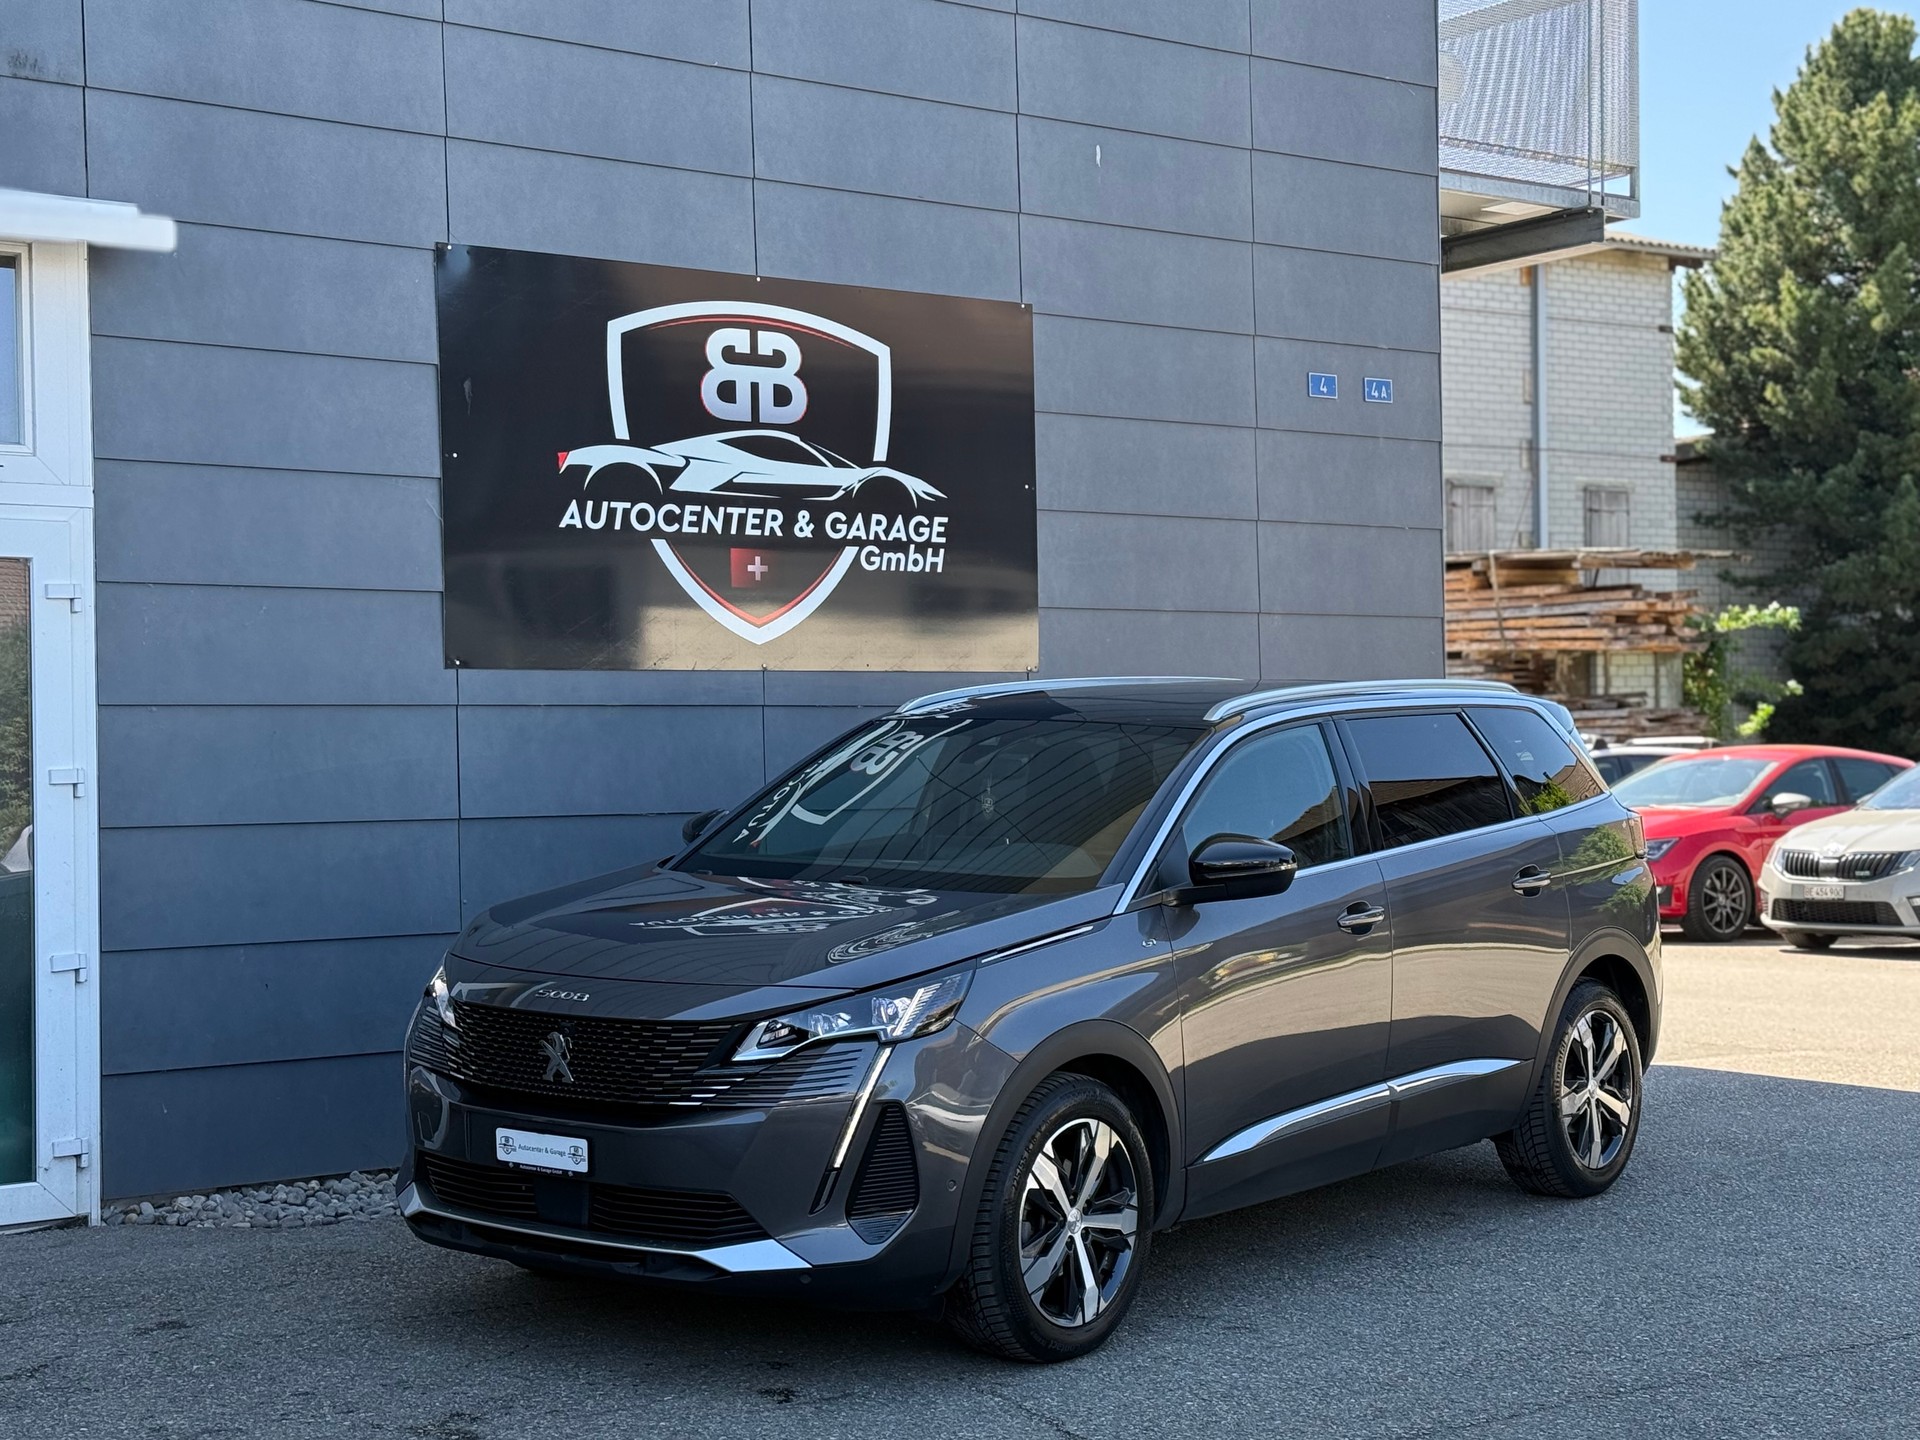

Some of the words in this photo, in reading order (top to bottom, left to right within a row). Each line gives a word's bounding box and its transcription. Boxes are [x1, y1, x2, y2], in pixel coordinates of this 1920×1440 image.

[1320, 377, 1327, 394] 4
[558, 498, 784, 538] AUTOCENTER
[793, 509, 815, 539] &
[824, 511, 949, 544] GARAGE
[860, 543, 945, 573] GmbH
[535, 989, 590, 1002] 5008
